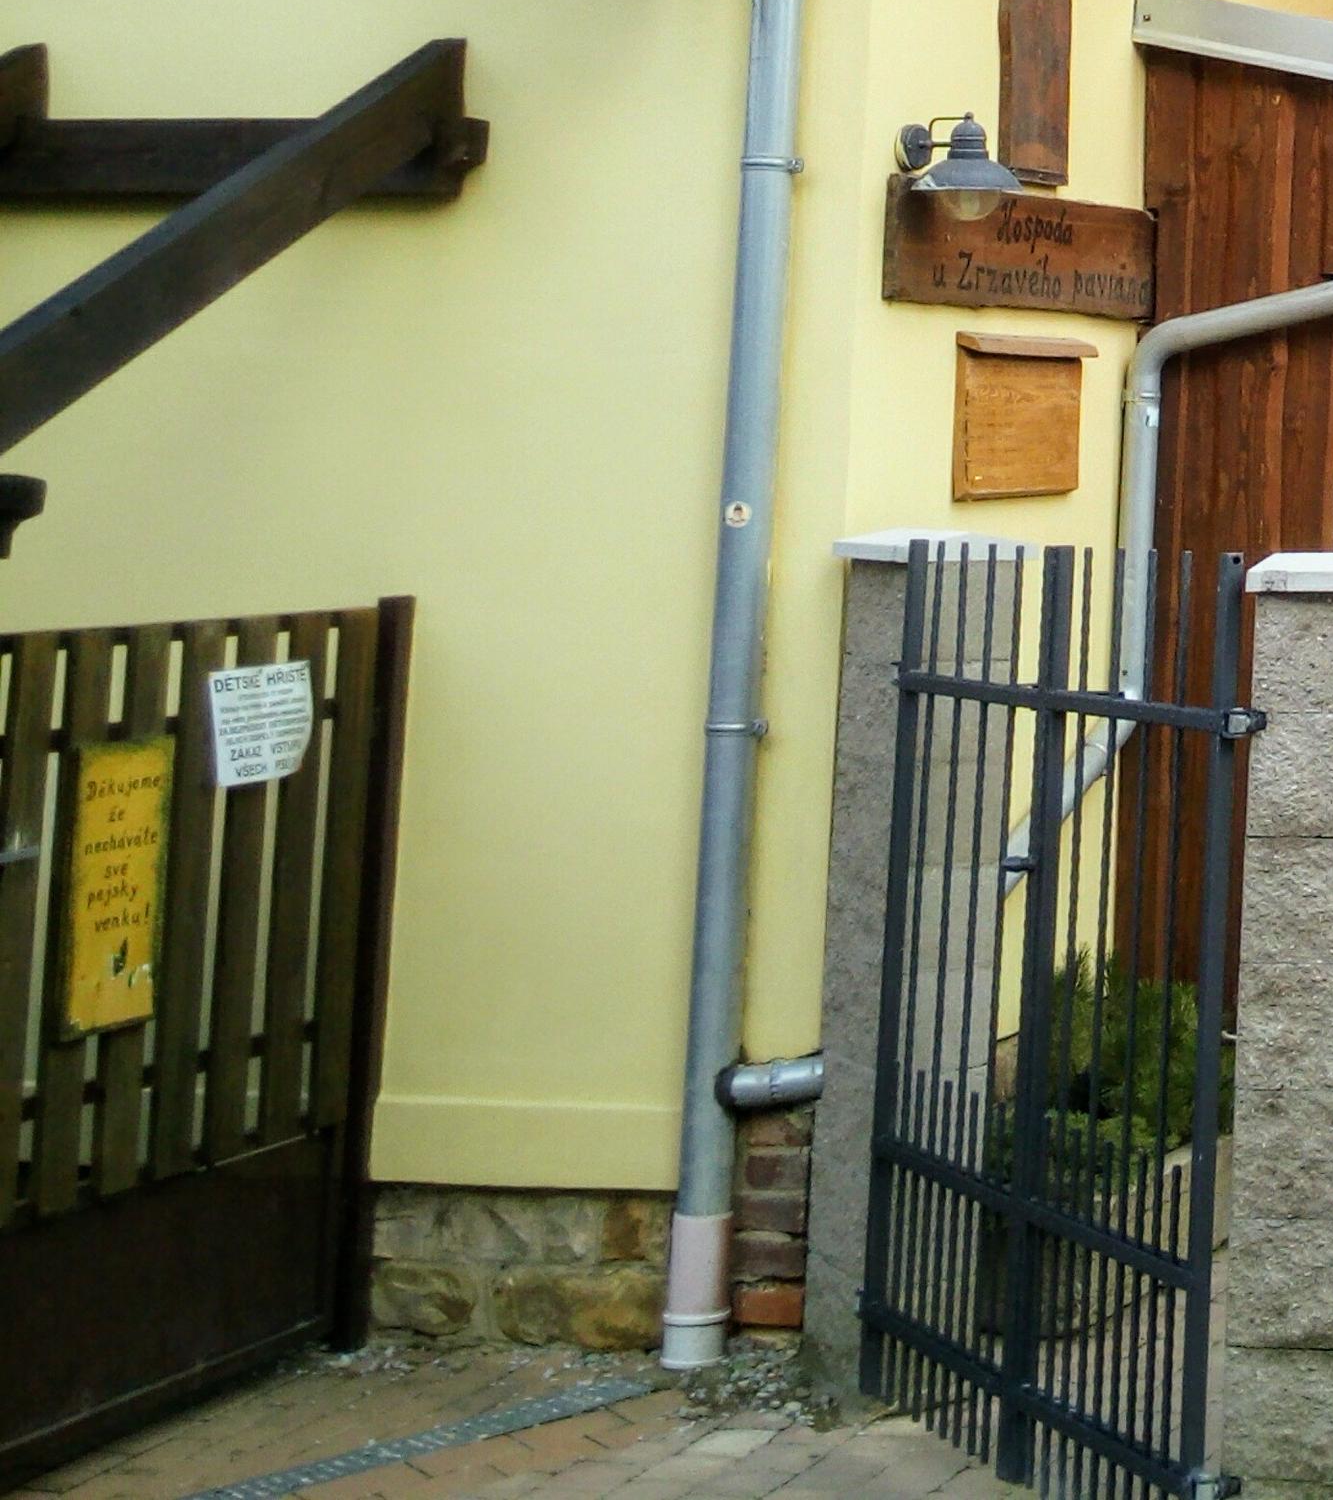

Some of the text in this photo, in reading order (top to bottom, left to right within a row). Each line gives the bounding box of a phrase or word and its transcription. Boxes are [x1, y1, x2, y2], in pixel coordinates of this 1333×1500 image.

[996, 199, 1073, 254] Hospoda
[933, 262, 946, 289] u
[87, 879, 138, 909] pejsky
[94, 902, 151, 934] venku!
